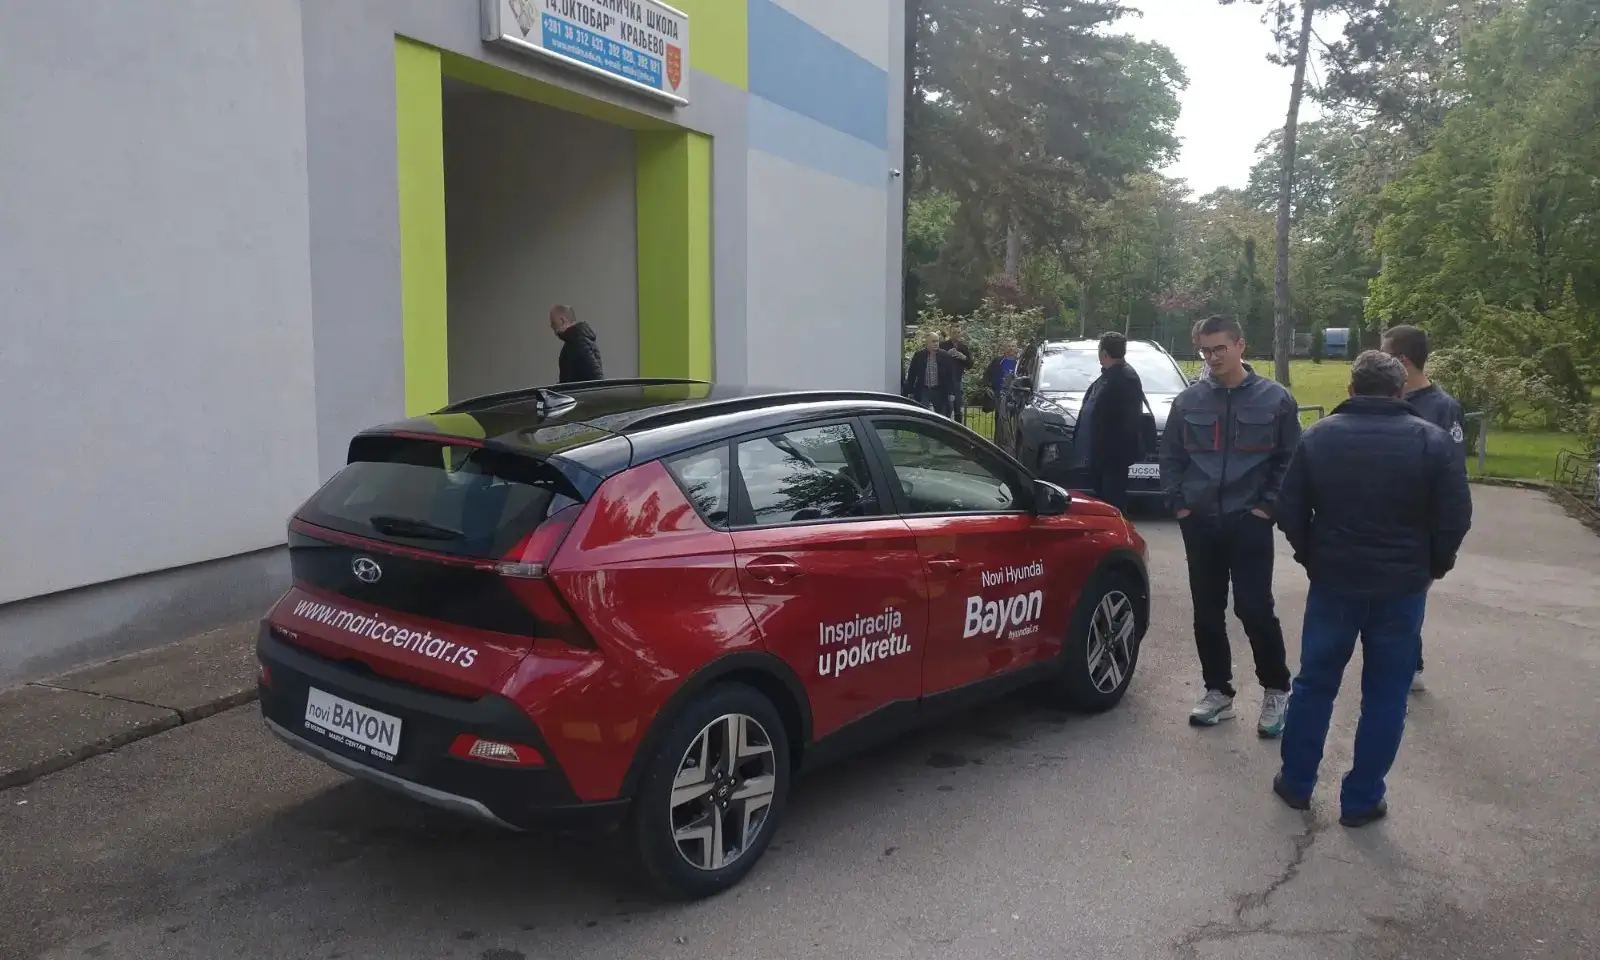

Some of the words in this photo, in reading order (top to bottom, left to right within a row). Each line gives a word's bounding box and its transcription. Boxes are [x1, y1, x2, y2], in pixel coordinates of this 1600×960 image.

[620, 21, 664, 56] КРАЉЕВО
[646, 8, 678, 40] ШКОЛА
[981, 566, 1004, 588] Novi
[1005, 558, 1044, 585] Hyundai
[819, 606, 902, 646] Inspiracija
[963, 589, 1043, 639] Bayon
[1007, 624, 1039, 640] hyundai.rs
[293, 599, 478, 668] www.mariccentar.rs
[818, 653, 831, 676] u
[835, 632, 912, 678] pokretu.
[309, 703, 331, 723] novi
[332, 702, 395, 746] BAYON
[345, 738, 367, 752] CENTAR
